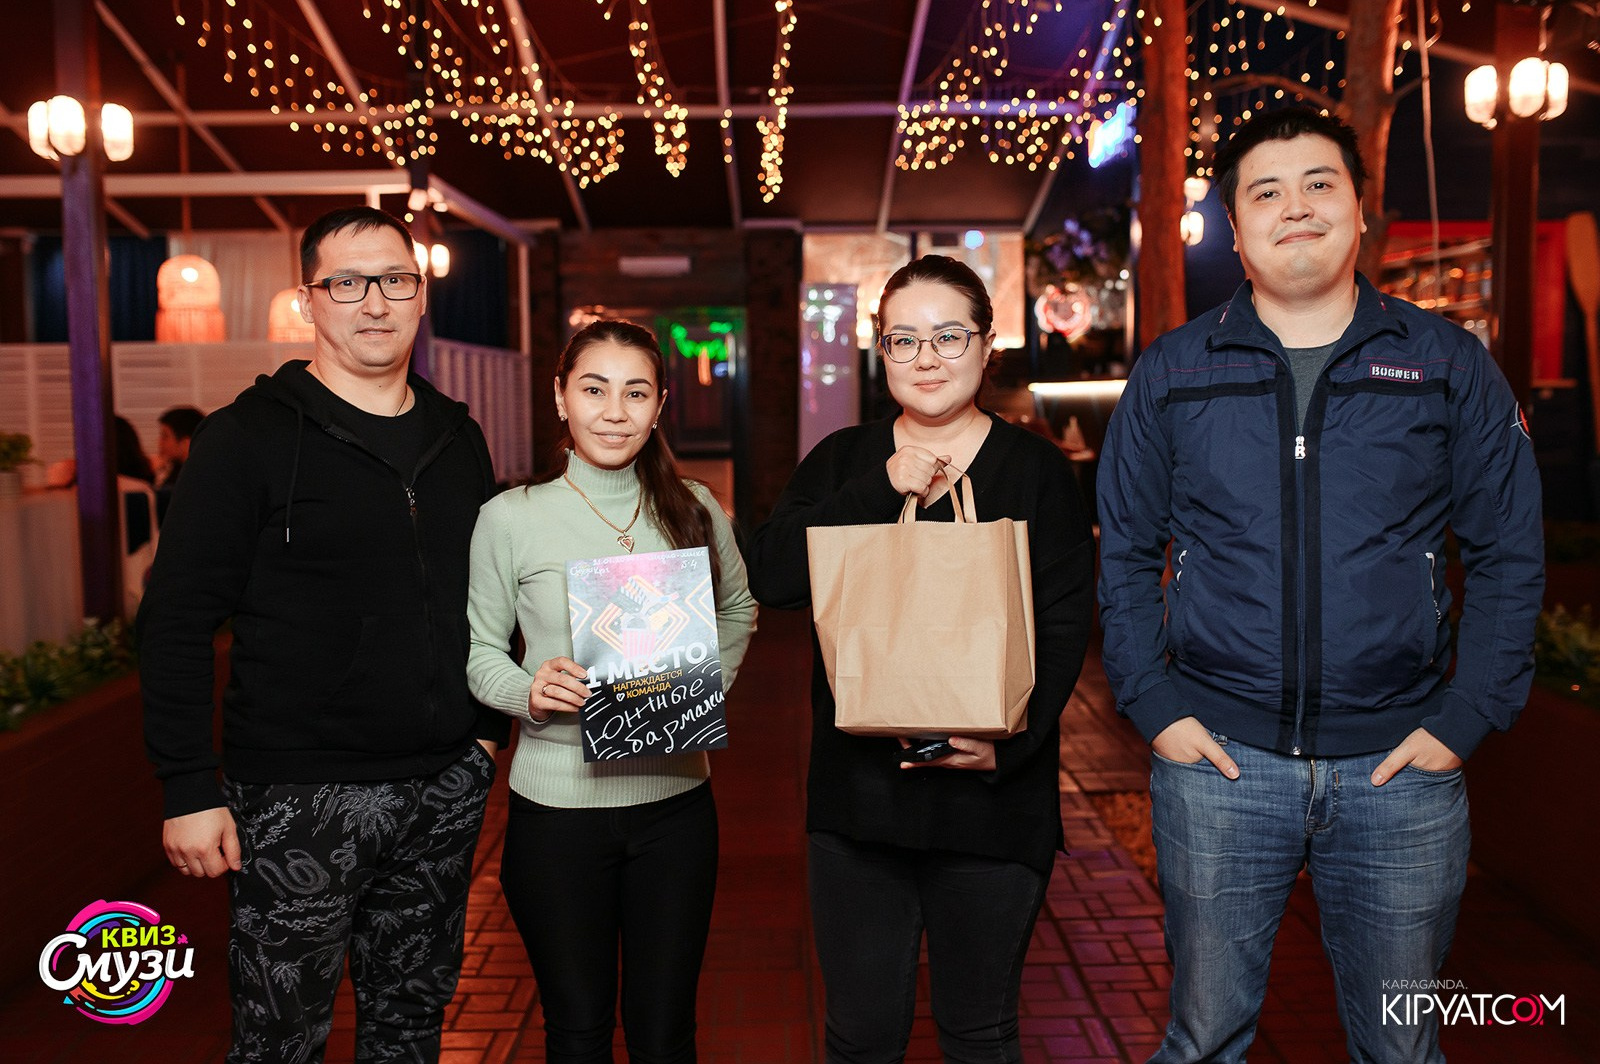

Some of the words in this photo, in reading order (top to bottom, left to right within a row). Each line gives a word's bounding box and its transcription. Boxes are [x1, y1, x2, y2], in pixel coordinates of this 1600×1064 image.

[1371, 366, 1420, 380] BOGNER
[586, 666, 602, 688] 1
[606, 642, 708, 685] МЕСТО
[613, 669, 683, 692] НАГРАЖДАЕТСЯ
[626, 682, 672, 698] КОМАНДА
